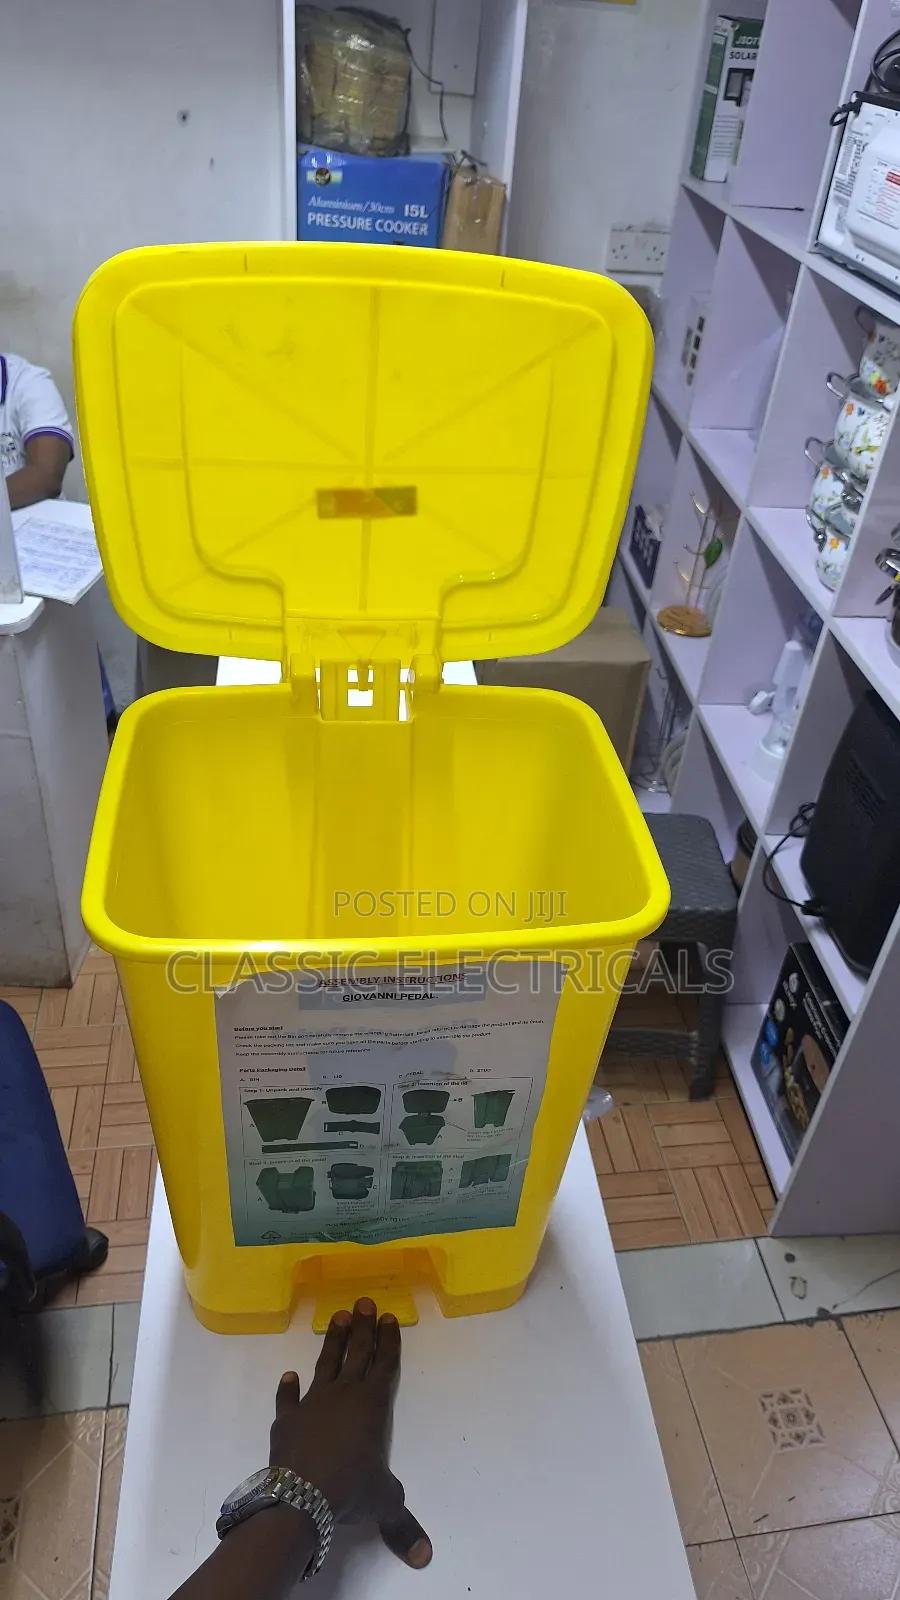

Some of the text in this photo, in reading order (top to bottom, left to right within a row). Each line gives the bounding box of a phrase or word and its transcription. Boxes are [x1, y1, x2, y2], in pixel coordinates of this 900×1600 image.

[729, 51, 757, 60] SOLAR
[403, 204, 430, 219] 15L
[307, 211, 429, 236] PRESSURE COOKER
[318, 973, 467, 987] ASSEMBLY INSTRUCTIONS
[342, 992, 397, 1002] GIOVANNI
